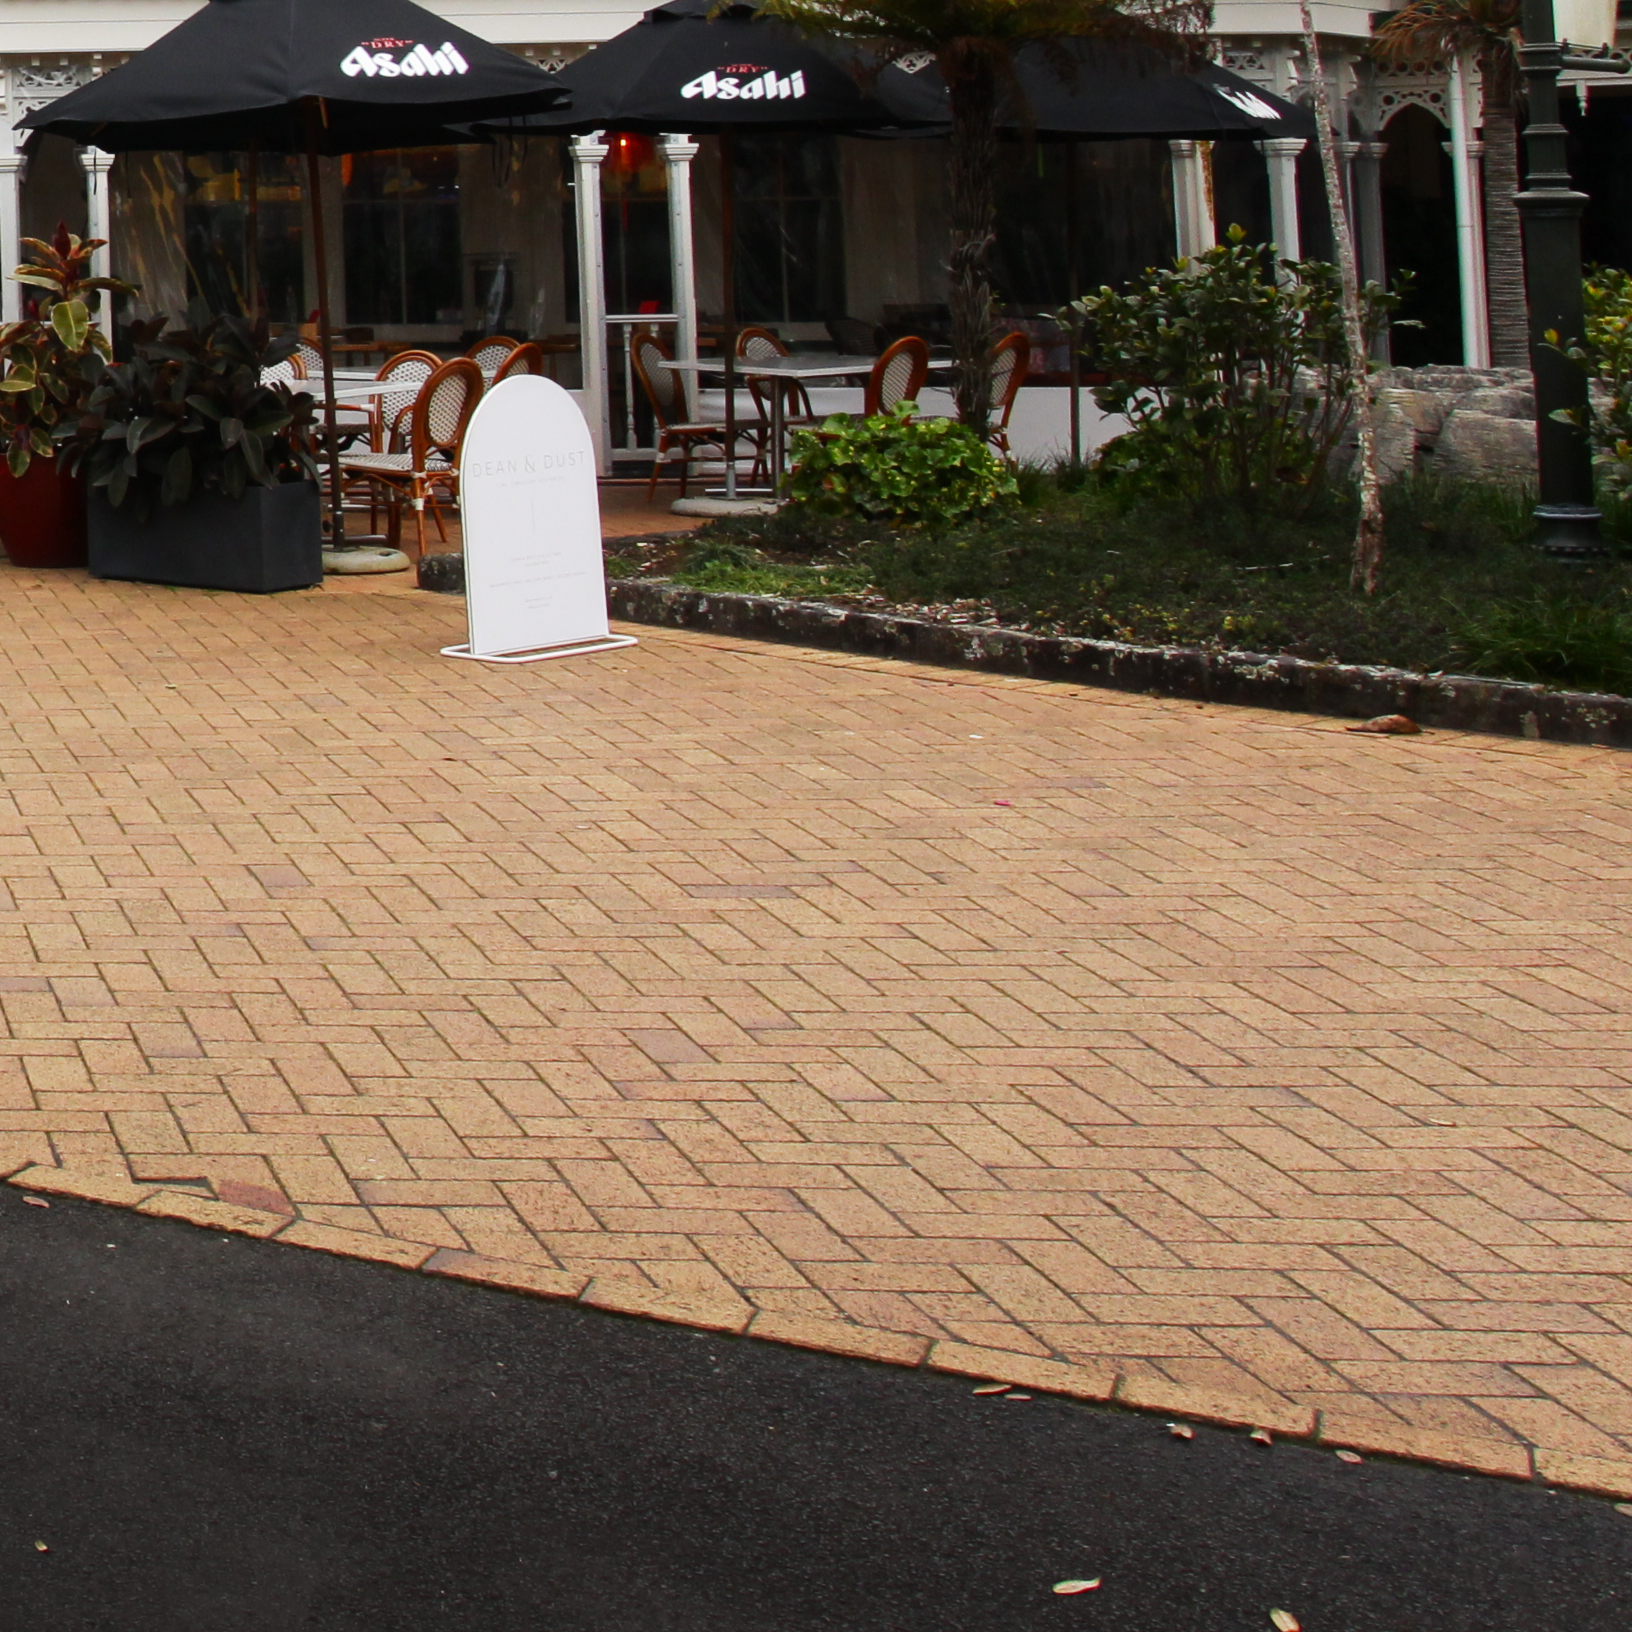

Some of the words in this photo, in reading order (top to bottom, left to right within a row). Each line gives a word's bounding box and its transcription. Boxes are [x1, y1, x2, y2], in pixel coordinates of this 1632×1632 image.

[340, 41, 469, 77] Asahi
[681, 69, 806, 100] Asahi
[472, 459, 517, 478] DEAN
[524, 454, 537, 474] &
[543, 450, 585, 469] DUST
